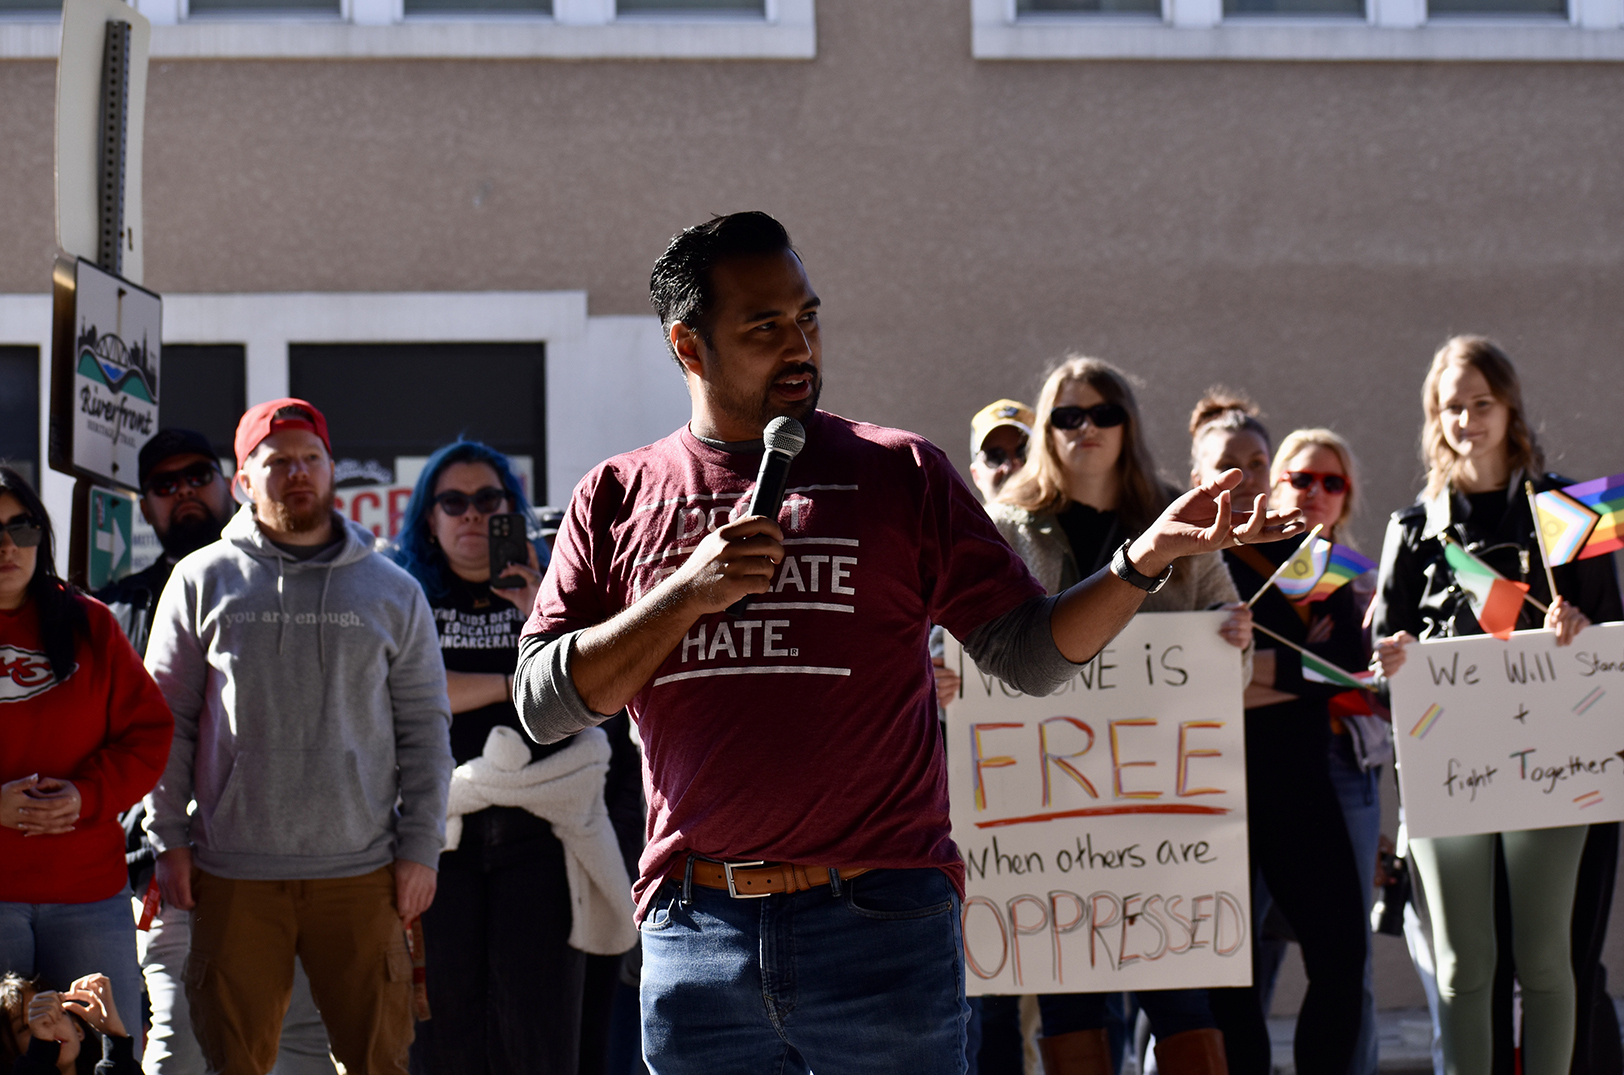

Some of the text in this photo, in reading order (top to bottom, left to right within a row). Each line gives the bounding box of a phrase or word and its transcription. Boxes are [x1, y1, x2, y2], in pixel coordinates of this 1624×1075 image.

[81, 384, 153, 446] Riverfront
[675, 498, 810, 541] DOT
[225, 610, 365, 629] you are enough.
[440, 633, 519, 650] INCARCERAT
[443, 621, 512, 636] EDUCATION
[1427, 651, 1481, 686] We
[1503, 649, 1556, 685] Will
[970, 716, 1227, 812] FREE
[1508, 747, 1616, 794] Together
[960, 833, 1217, 881] When others are
[962, 890, 1246, 986] OPPRESSED
